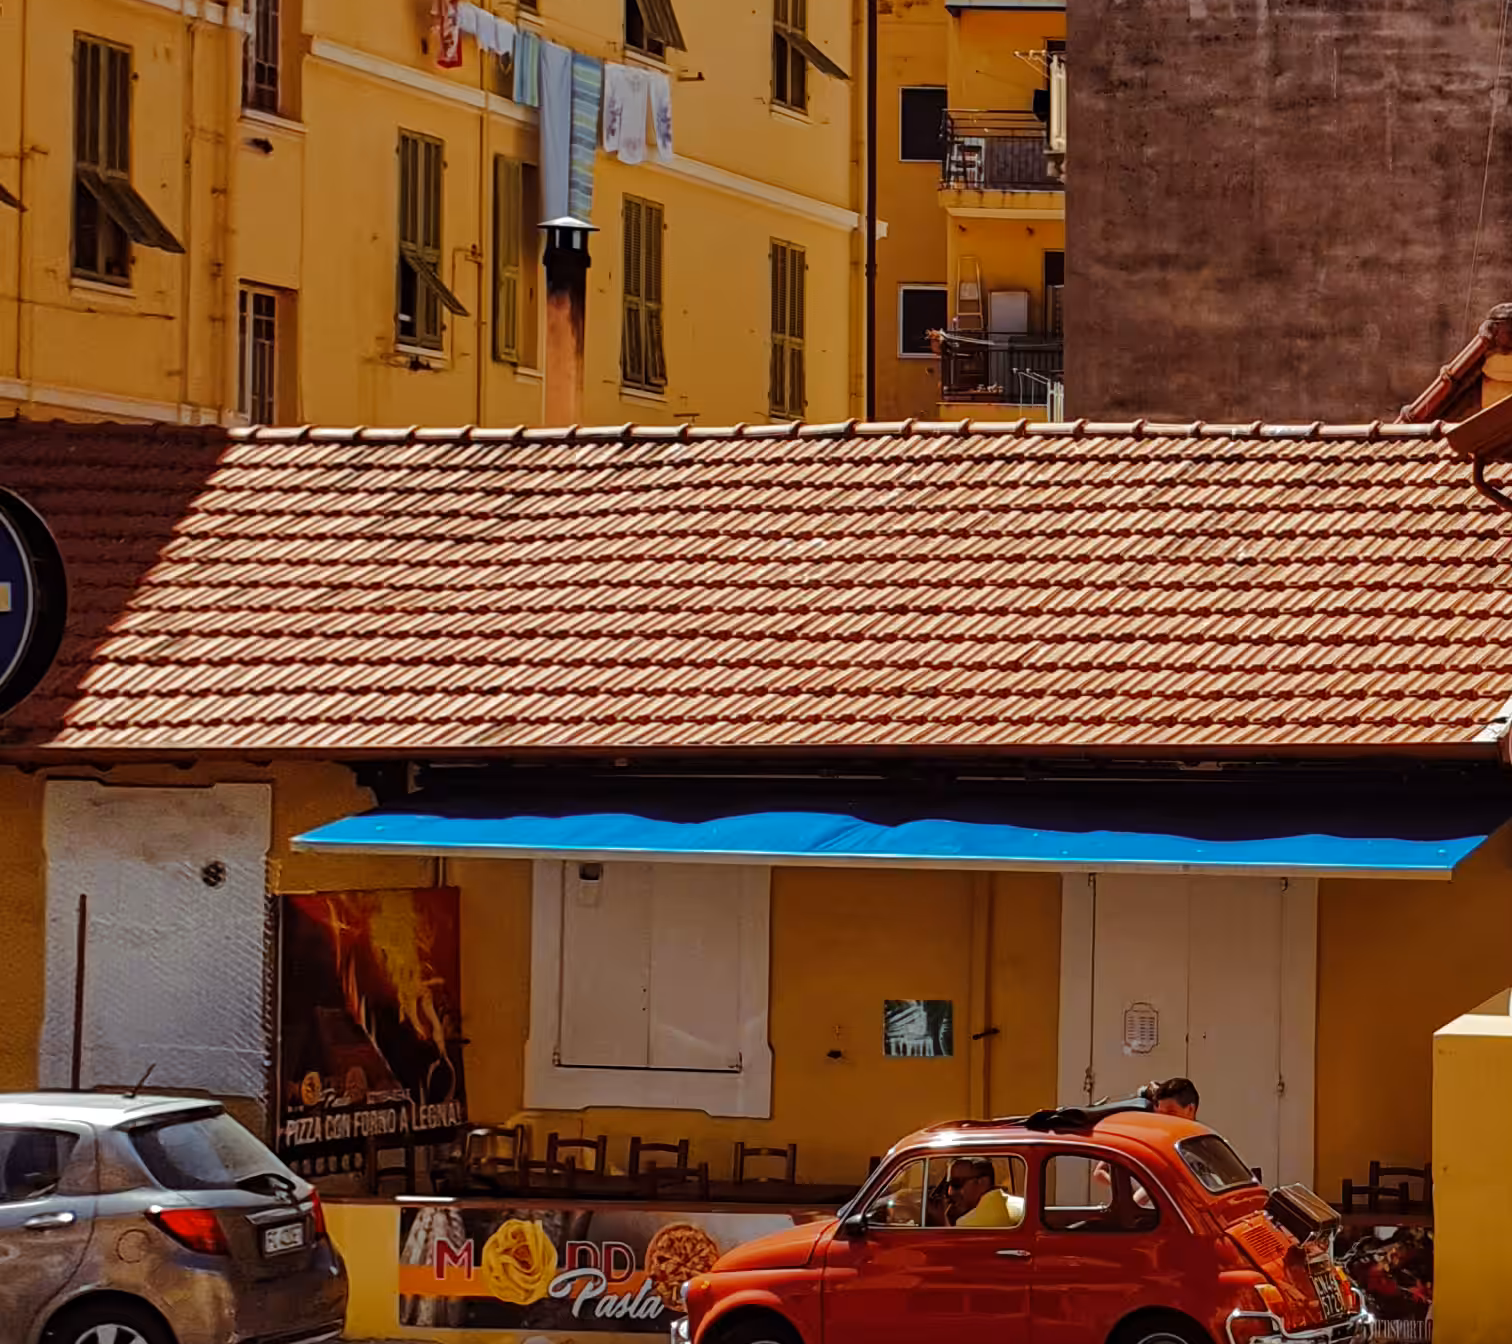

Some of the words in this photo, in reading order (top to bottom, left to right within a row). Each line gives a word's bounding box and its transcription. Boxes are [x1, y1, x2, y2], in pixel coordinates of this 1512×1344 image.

[286, 1117, 322, 1147] PIZZA
[325, 1113, 350, 1140] CON
[353, 1108, 396, 1138] FORNO
[400, 1106, 409, 1133] A
[411, 1100, 462, 1131] LEGNA!
[548, 1267, 665, 1320] Pasta
